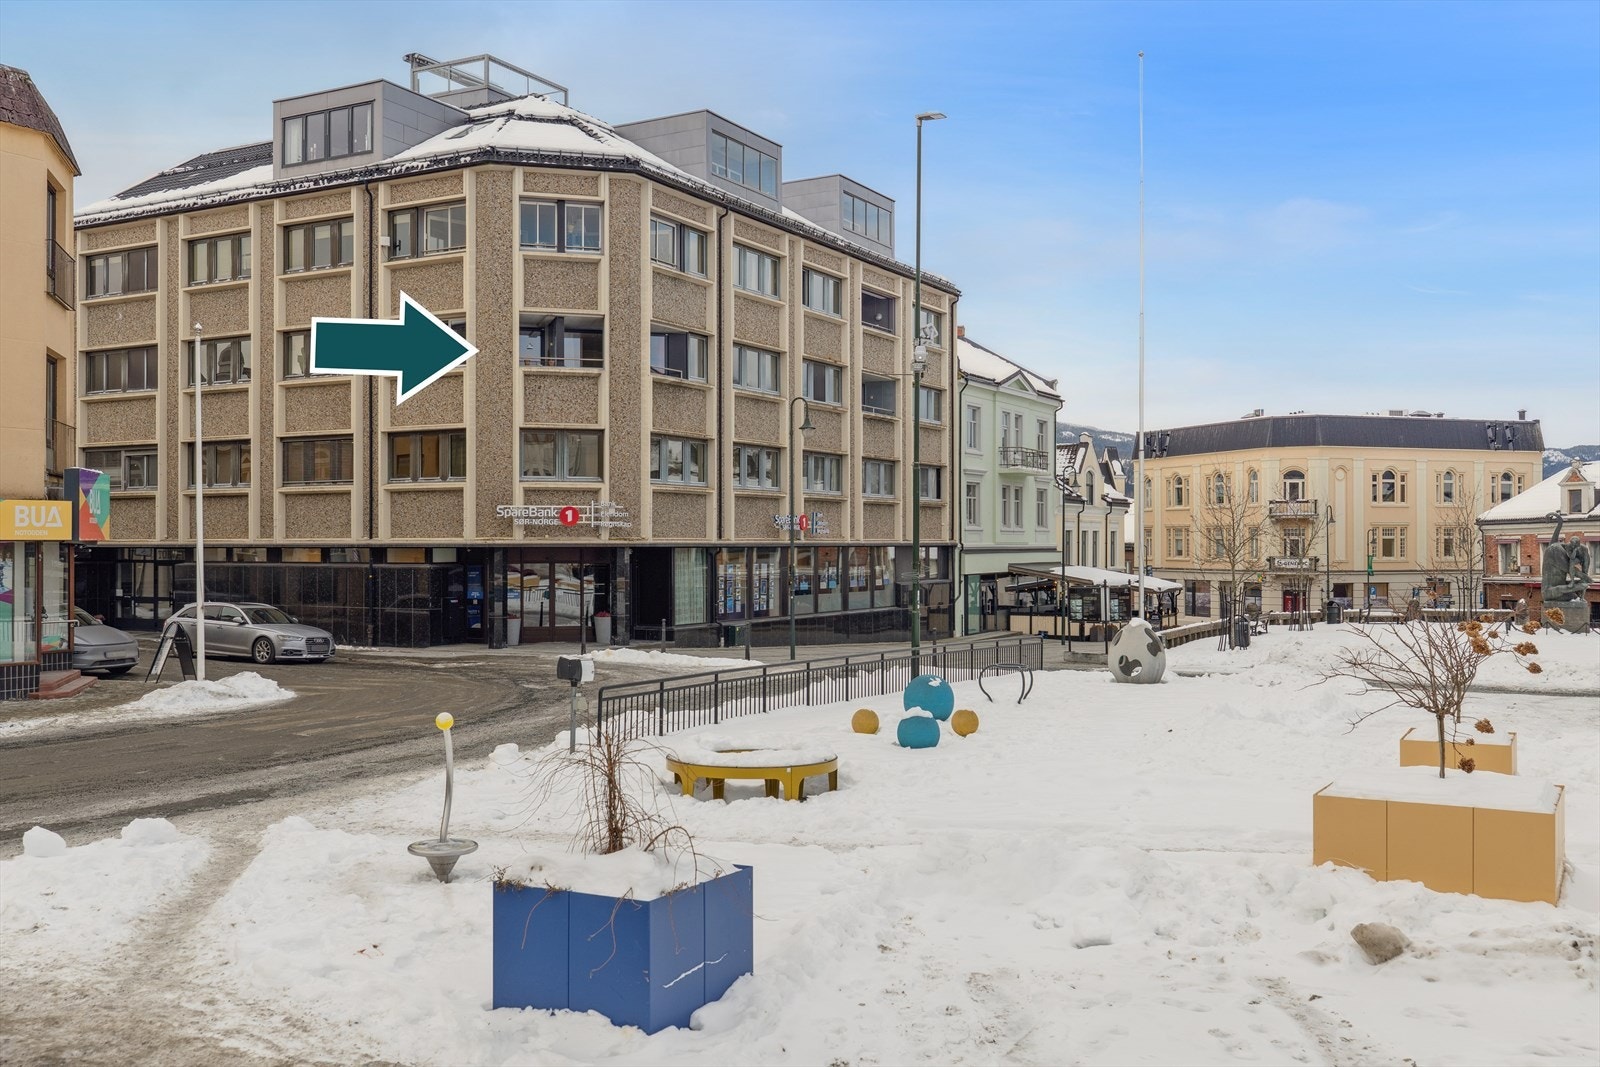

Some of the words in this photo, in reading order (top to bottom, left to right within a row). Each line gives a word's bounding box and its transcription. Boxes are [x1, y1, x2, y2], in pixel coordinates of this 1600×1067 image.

[15, 505, 62, 527] BUA
[496, 506, 558, 518] SpareBank
[514, 518, 558, 526] SØR-NORGE
